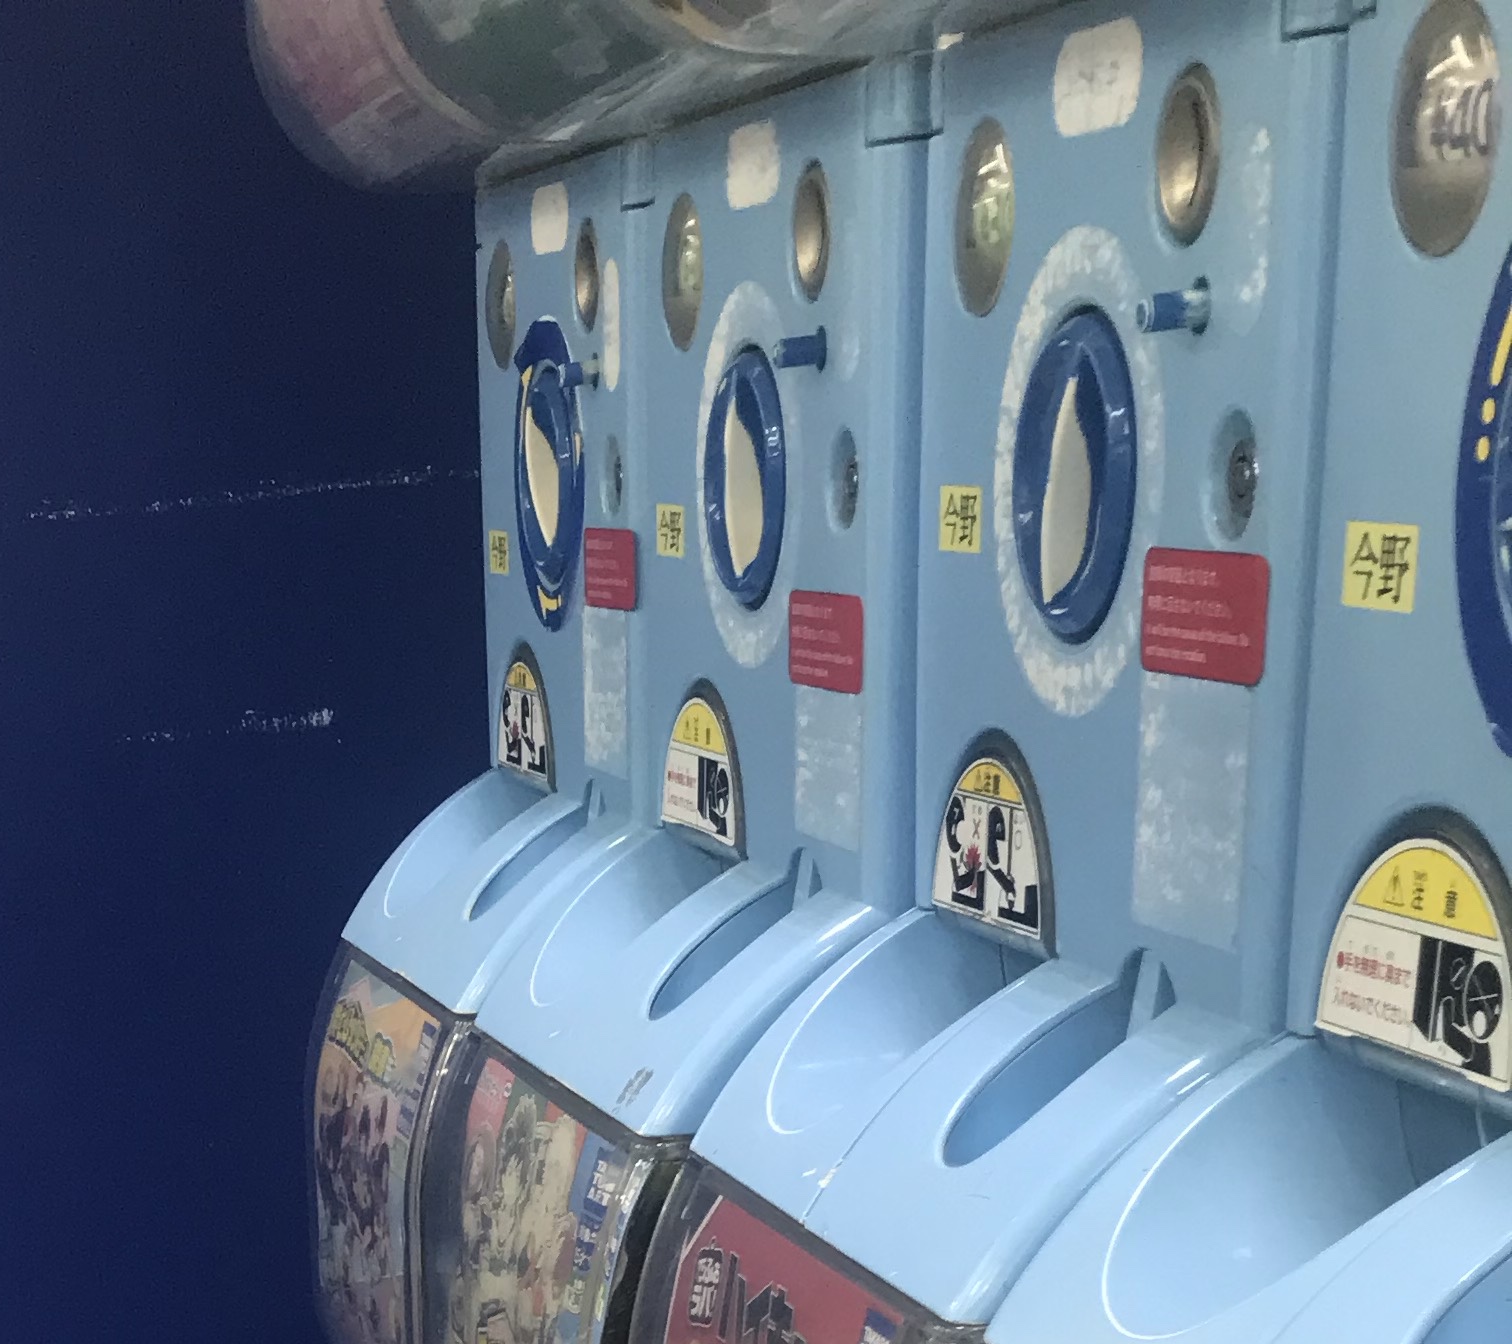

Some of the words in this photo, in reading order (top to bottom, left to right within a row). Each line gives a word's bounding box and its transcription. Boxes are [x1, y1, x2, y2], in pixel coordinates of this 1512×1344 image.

[658, 508, 682, 553] 今野
[944, 494, 979, 547] 今野
[1350, 533, 1413, 605] 今野
